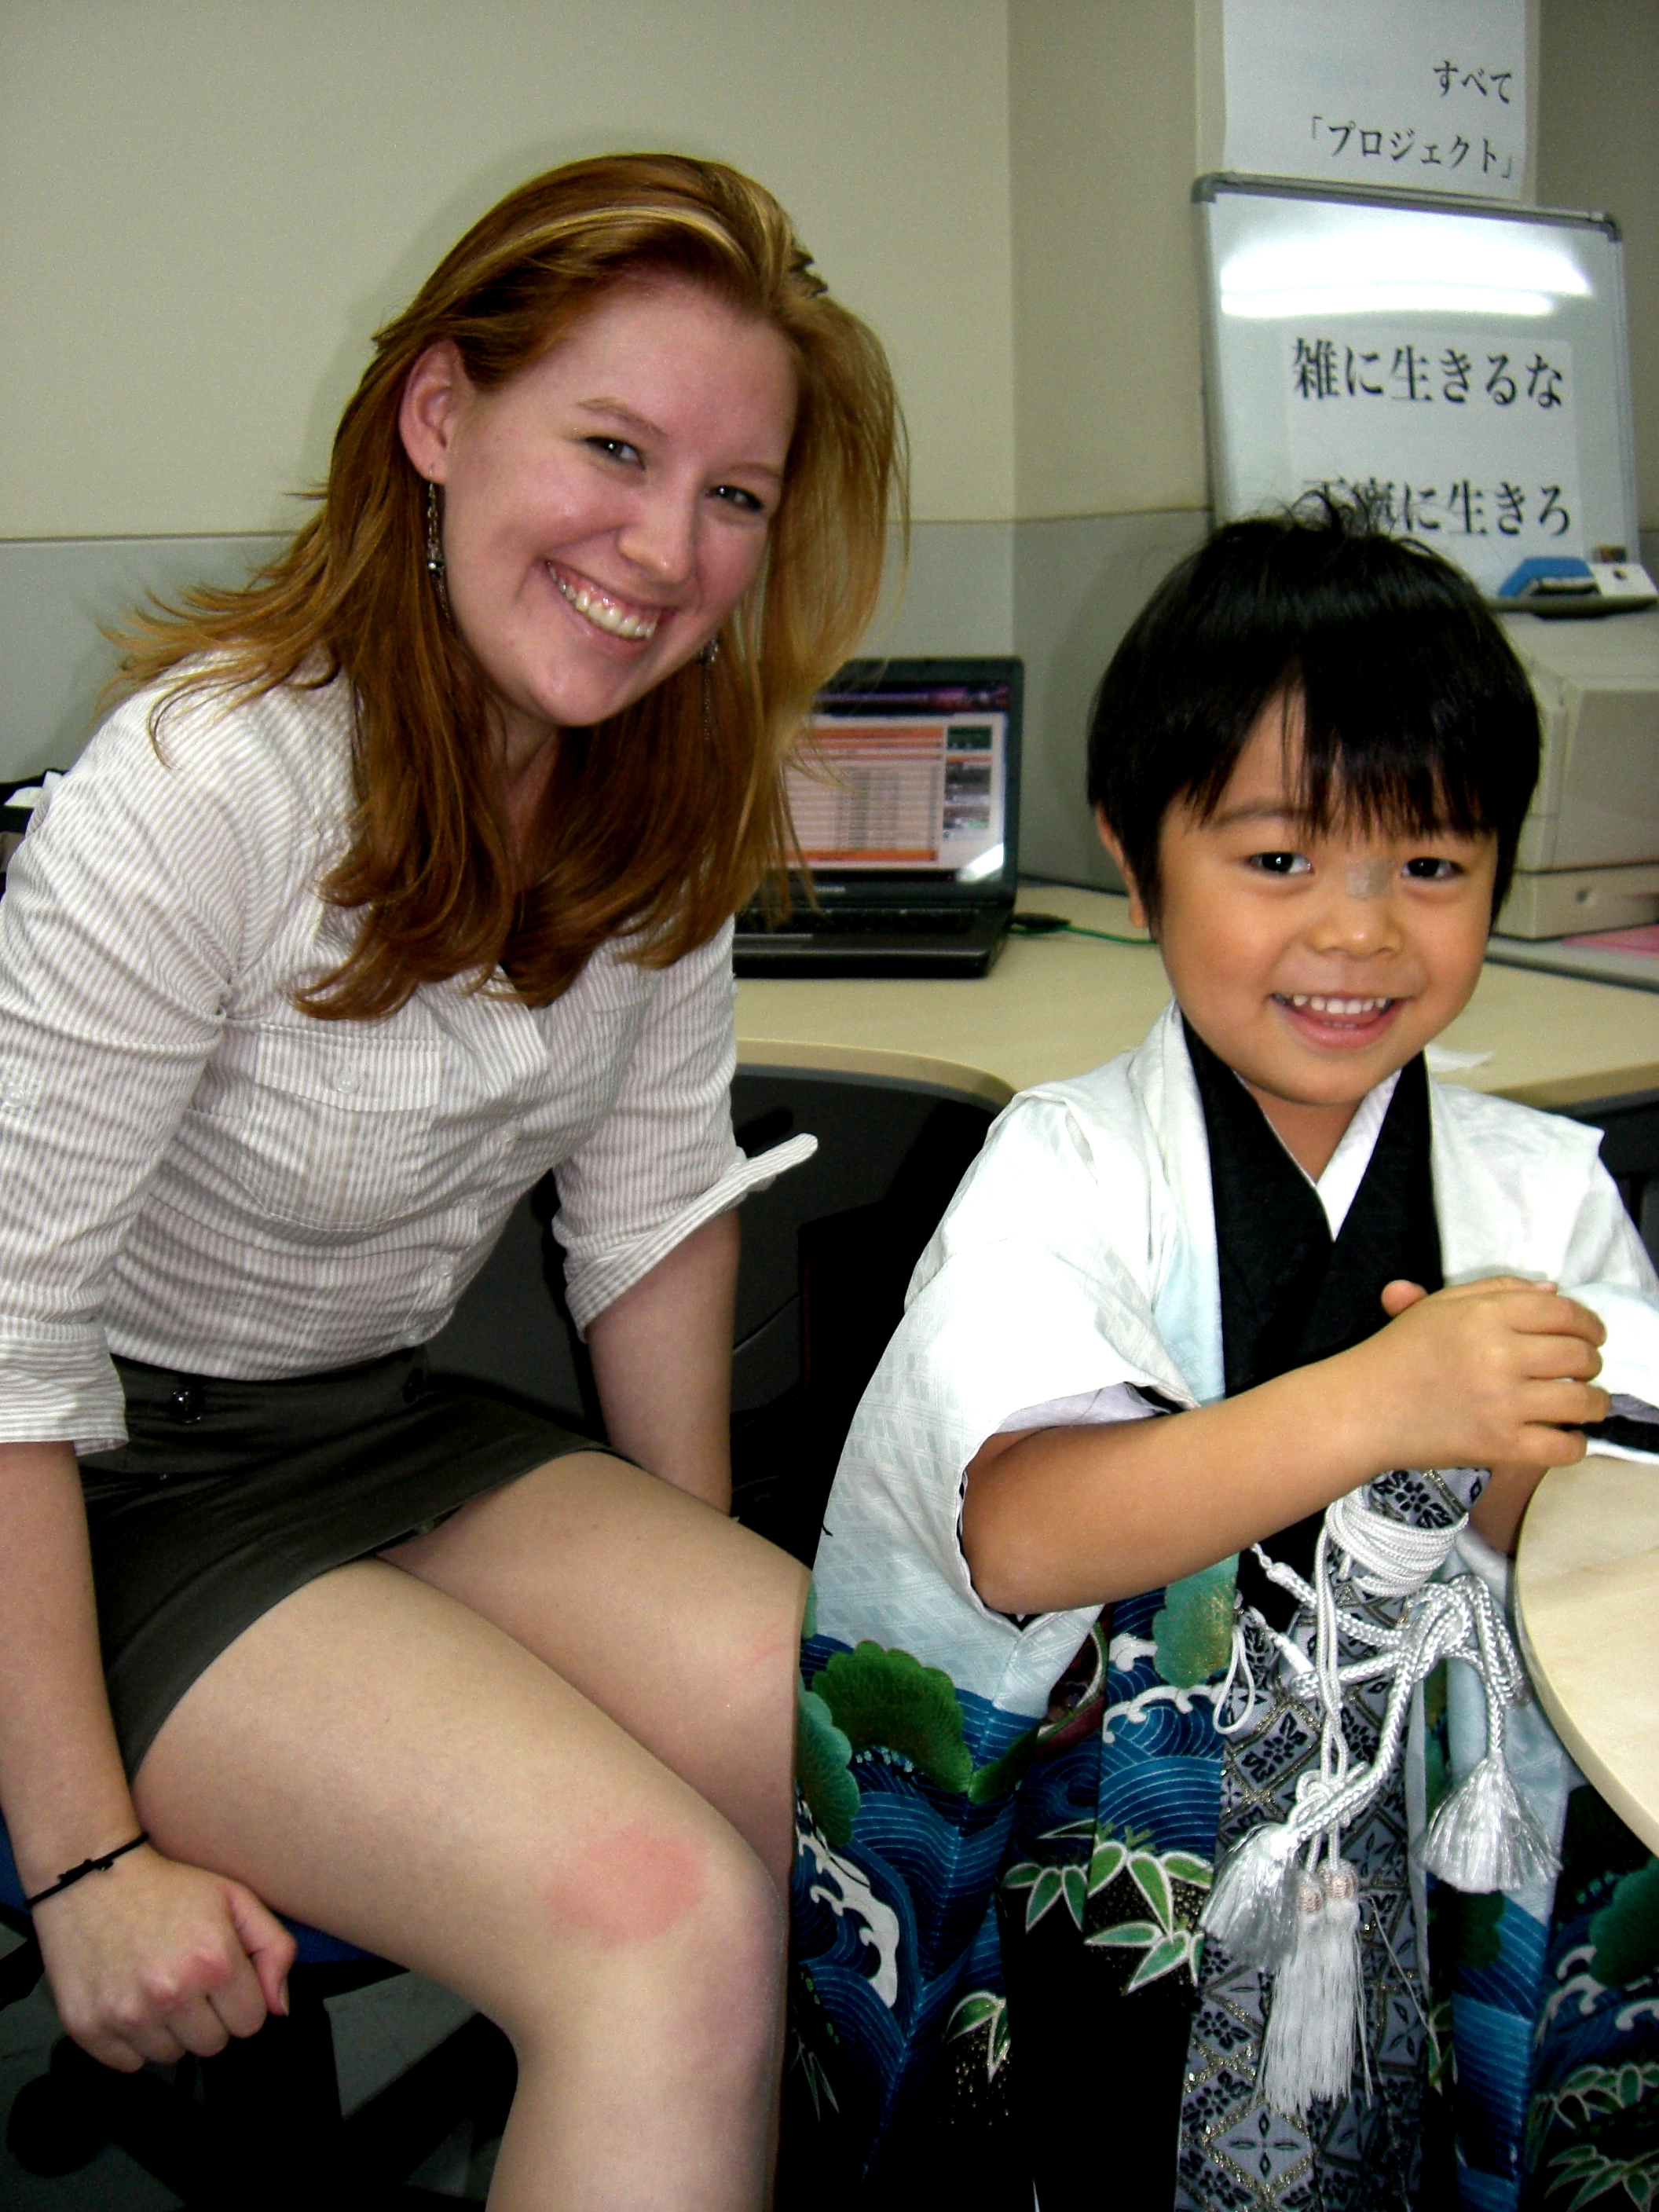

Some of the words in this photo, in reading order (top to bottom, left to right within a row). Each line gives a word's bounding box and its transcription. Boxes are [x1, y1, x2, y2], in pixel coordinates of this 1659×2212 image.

[1433, 60, 1512, 104] すべて
[1312, 115, 1511, 178] 「プロジェクト」
[1292, 336, 1562, 408] 雑に生きるな
